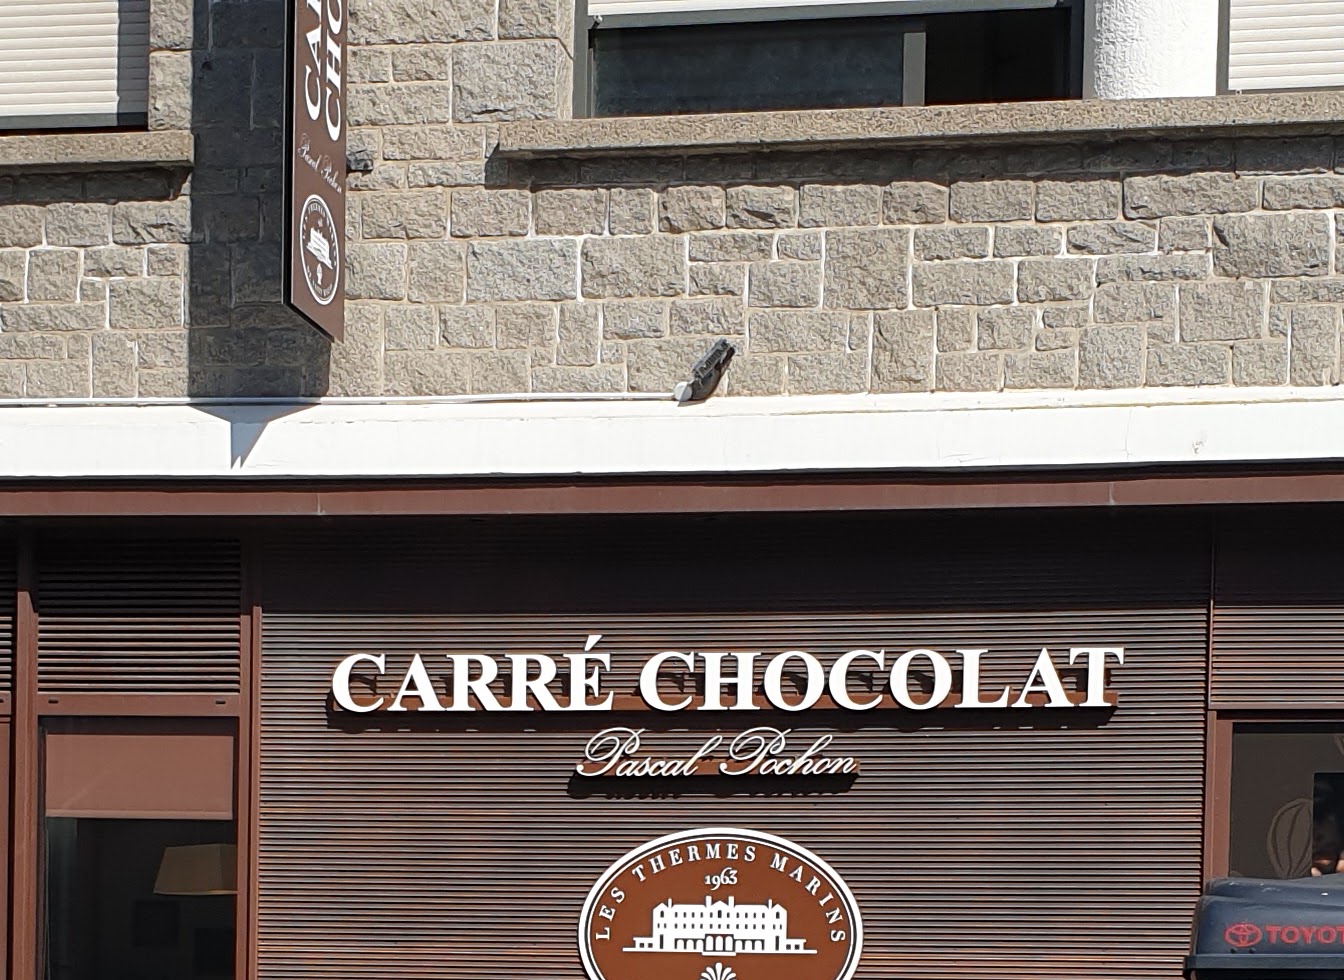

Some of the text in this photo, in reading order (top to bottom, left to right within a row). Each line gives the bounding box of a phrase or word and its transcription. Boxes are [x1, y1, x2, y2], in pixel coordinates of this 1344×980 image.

[332, 634, 1125, 713] CARRÉ CHOCOLAT
[576, 726, 857, 777] Pascal Pochon
[595, 843, 846, 943] LES THERMES MARINS
[704, 867, 738, 890] 1963
